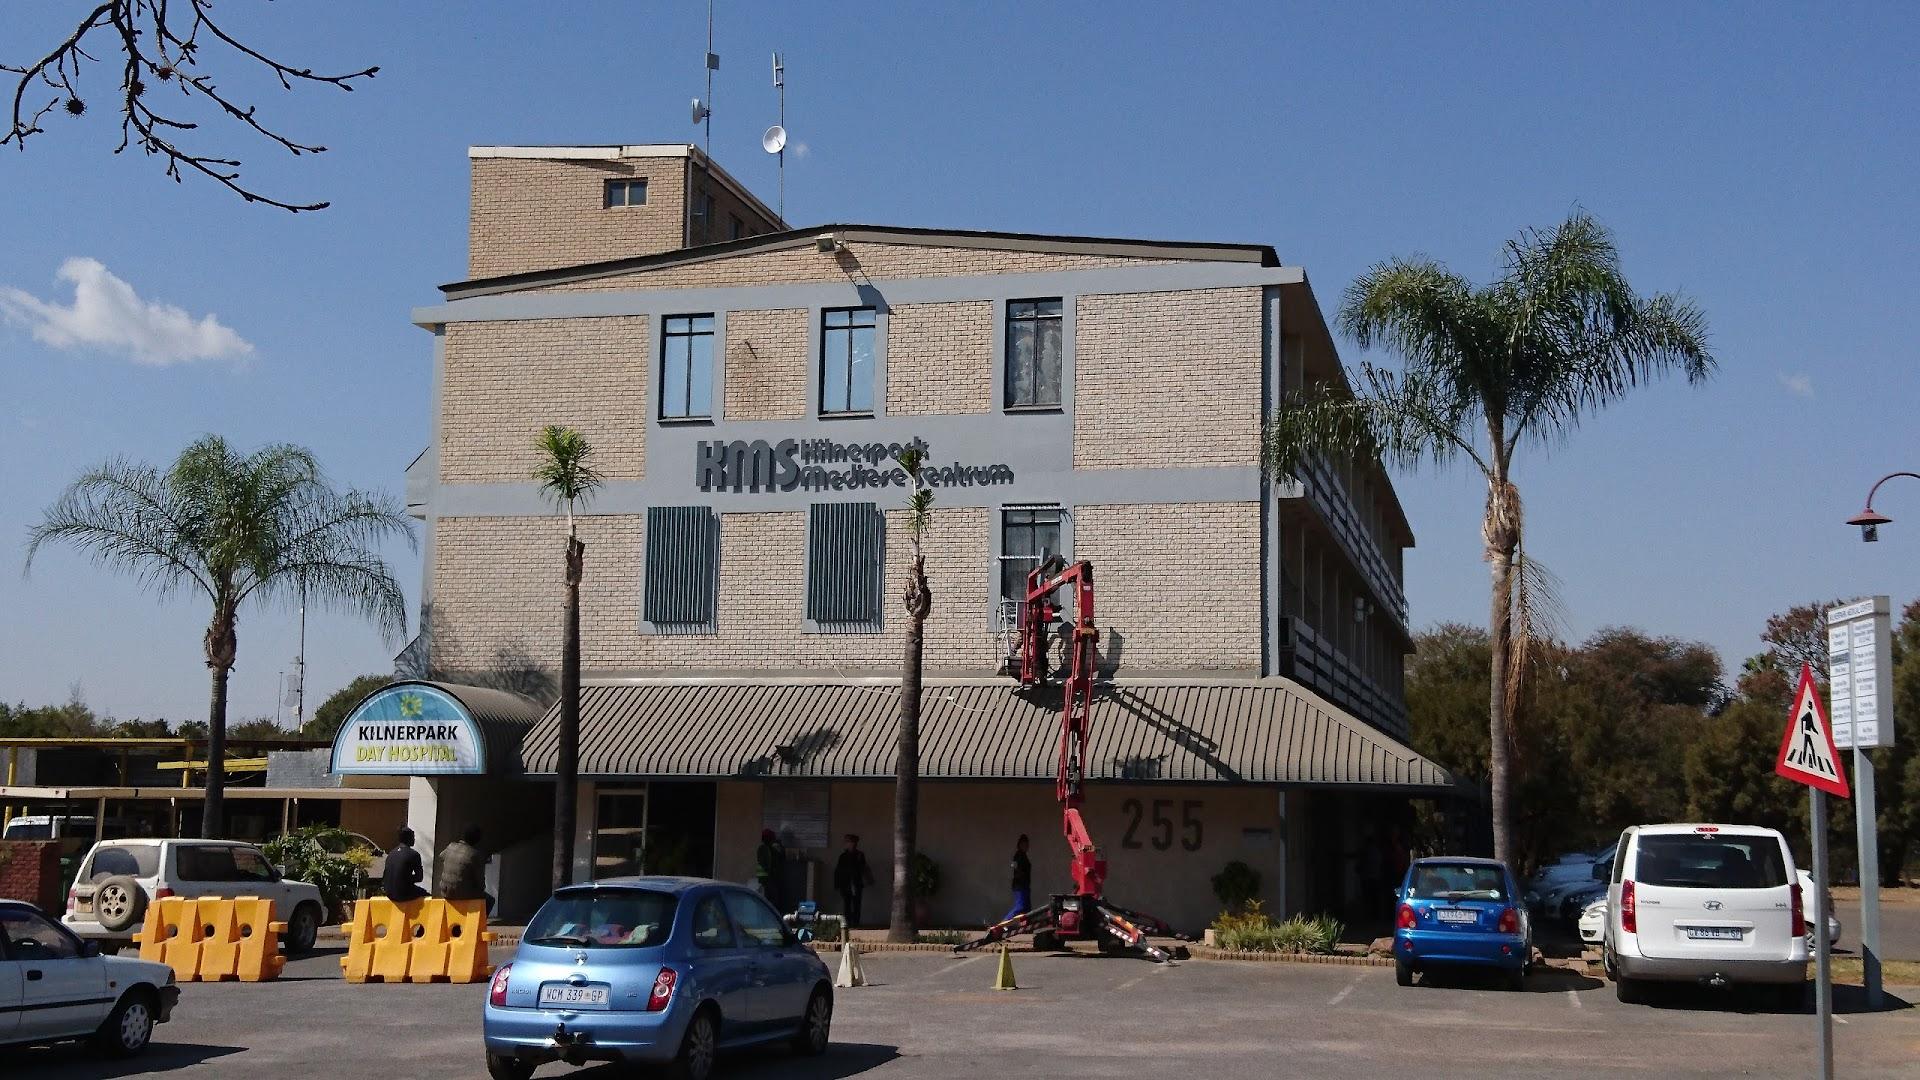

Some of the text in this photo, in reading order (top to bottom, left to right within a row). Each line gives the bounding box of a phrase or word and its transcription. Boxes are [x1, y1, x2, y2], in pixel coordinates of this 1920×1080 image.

[696, 438, 800, 493] KMS
[358, 725, 458, 741] KILNERPARK
[356, 745, 457, 761] DAY HOSPITAL
[1121, 799, 1204, 852] 255
